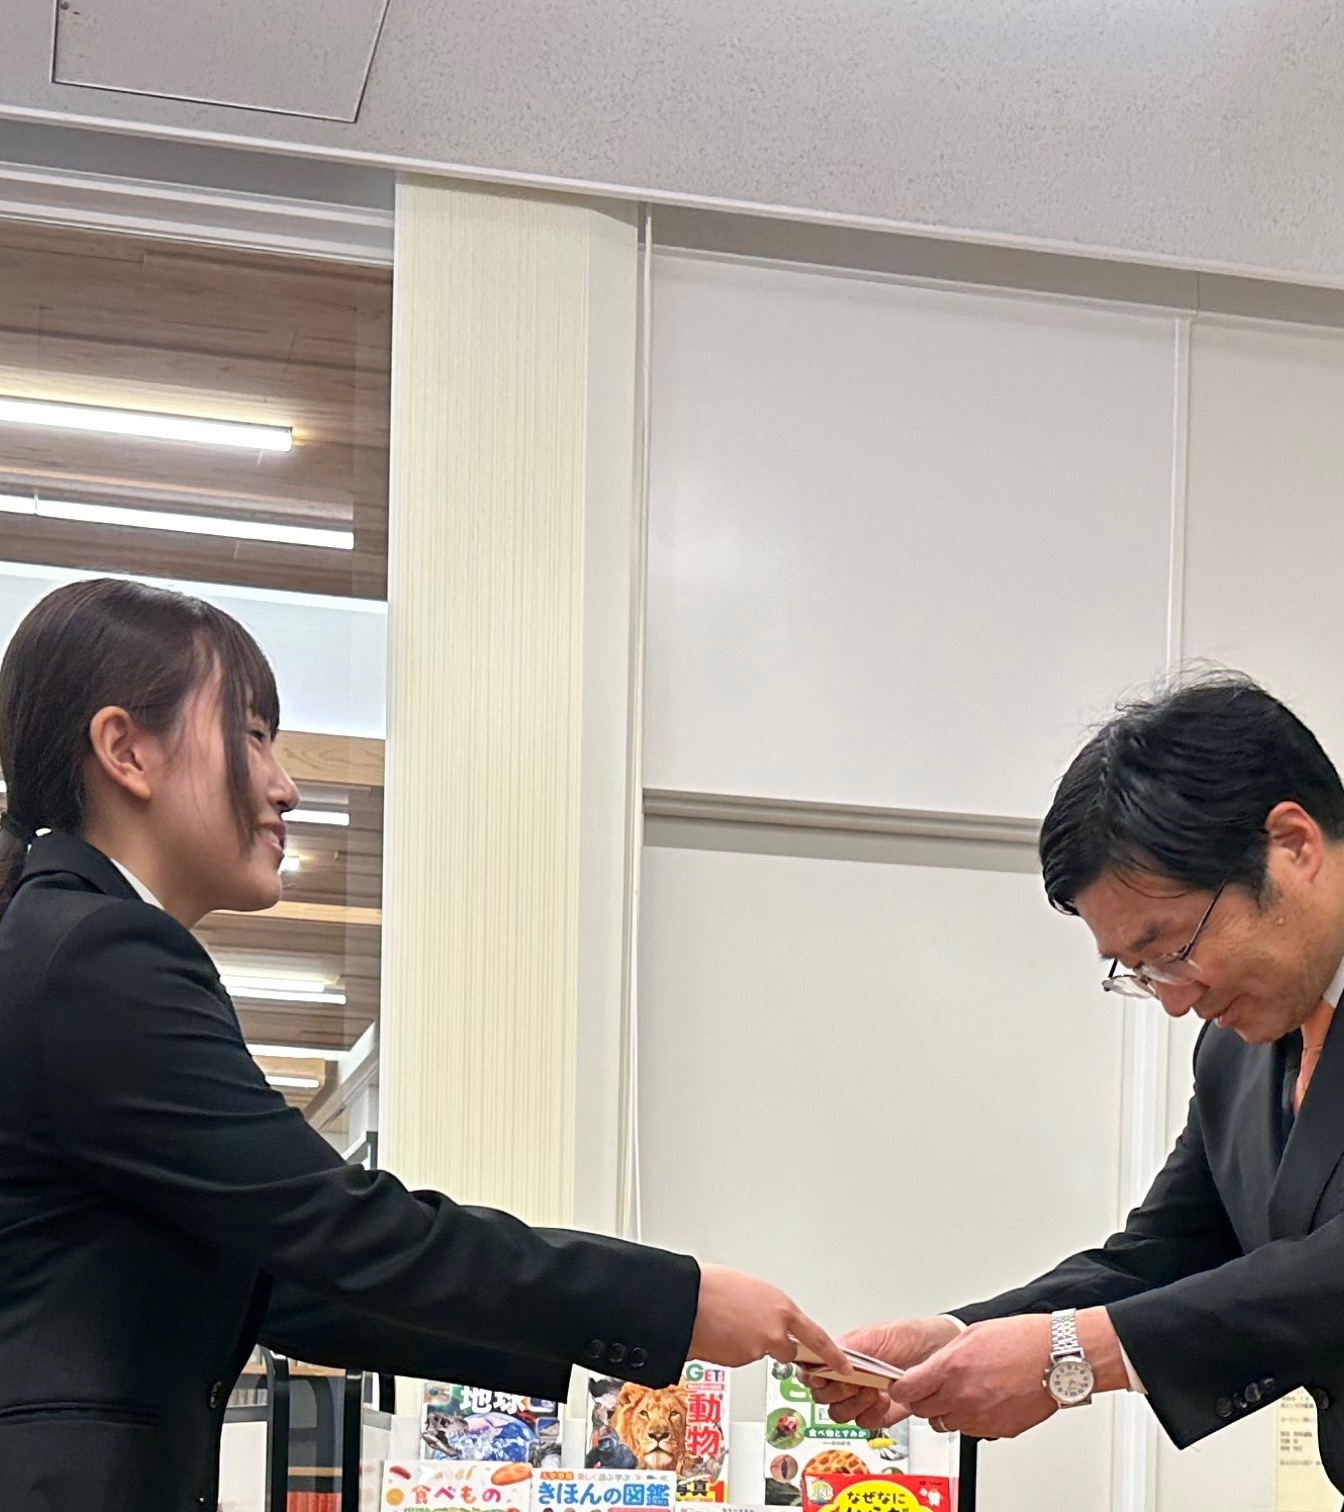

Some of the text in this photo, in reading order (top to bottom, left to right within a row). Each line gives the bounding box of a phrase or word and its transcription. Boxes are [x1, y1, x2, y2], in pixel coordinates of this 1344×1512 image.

[686, 1363, 725, 1382] GET!
[459, 1385, 530, 1414] 地球
[687, 1393, 721, 1456] 動物
[411, 1484, 502, 1505] 食べもの
[538, 1482, 670, 1507] きほんの図鑑
[847, 1491, 906, 1504] なぜなに
